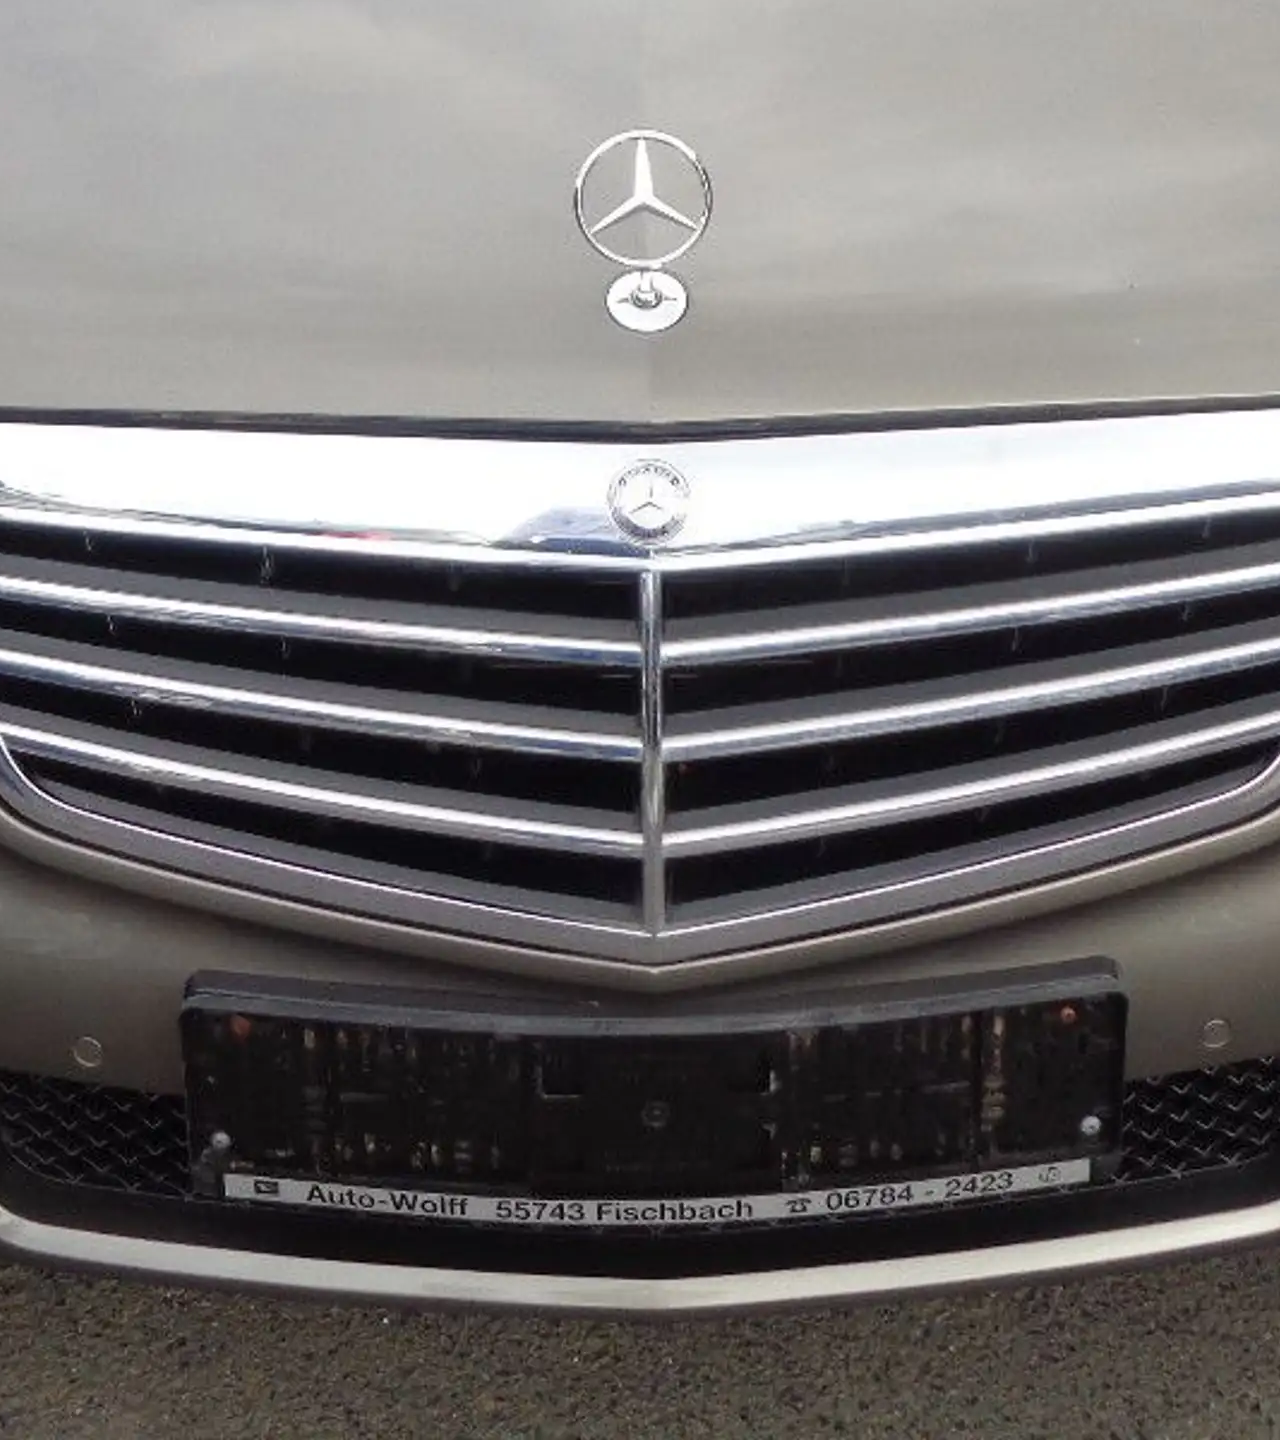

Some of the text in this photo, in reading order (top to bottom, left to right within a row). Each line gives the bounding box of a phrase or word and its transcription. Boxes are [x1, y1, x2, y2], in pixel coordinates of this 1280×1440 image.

[306, 1183, 469, 1217] Auto-Wolff
[495, 1200, 586, 1221] 55743
[596, 1201, 753, 1222] Fischbach
[826, 1186, 914, 1212] 06784
[945, 1171, 1015, 1198] 2423
